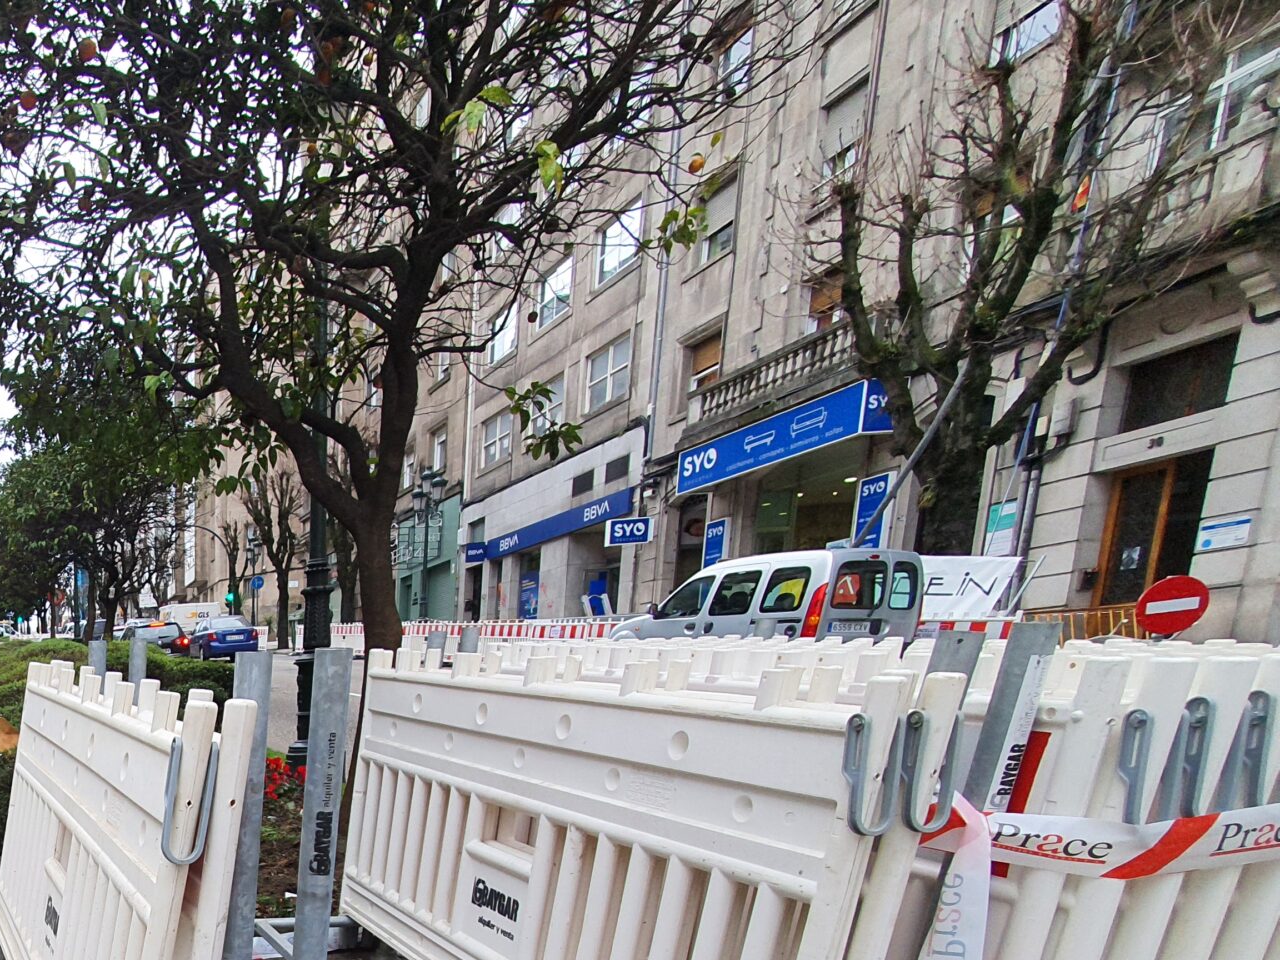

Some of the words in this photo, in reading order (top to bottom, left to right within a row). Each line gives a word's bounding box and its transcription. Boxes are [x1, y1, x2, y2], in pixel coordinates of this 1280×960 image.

[869, 394, 888, 410] SY
[683, 448, 718, 478] SYO
[862, 480, 886, 497] SYO
[584, 500, 610, 522] BBVA
[614, 522, 646, 538] SYO
[707, 526, 723, 538] SYO
[499, 533, 519, 552] BBVA
[467, 548, 484, 556] BBVA
[327, 732, 337, 759] venta
[322, 773, 333, 808] alquiler
[992, 821, 1113, 859] Prace
[501, 928, 514, 941] venta
